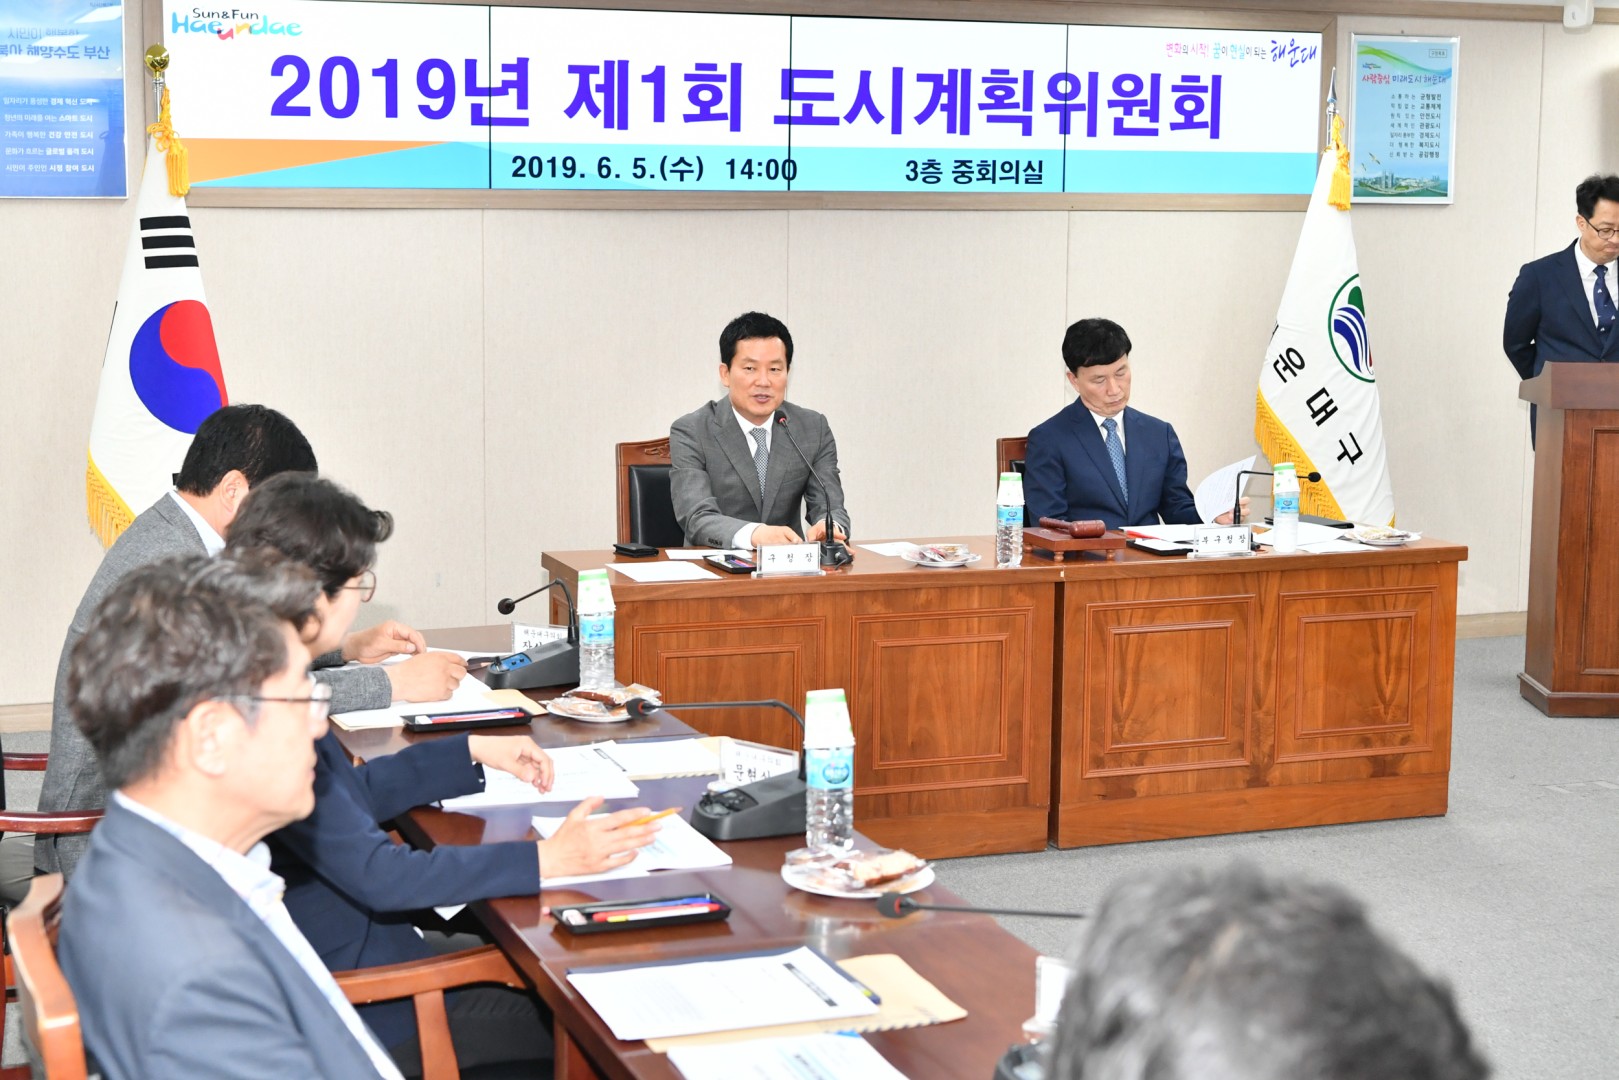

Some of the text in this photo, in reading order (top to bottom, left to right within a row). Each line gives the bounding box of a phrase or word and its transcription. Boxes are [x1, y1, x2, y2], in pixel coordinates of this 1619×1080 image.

[192, 7, 259, 20] Sun&Fun
[171, 11, 303, 41] Haeundae
[8, 27, 42, 40] 시민이
[26, 44, 80, 59] 해양수도
[84, 45, 111, 60] 부산
[1166, 38, 1318, 68] 변화의 시작! 꿈이 현실이 되는 해운대
[1362, 73, 1447, 85] 사람중심 미래도시 해운대
[3, 97, 28, 105] 일자리가
[50, 98, 64, 106] 경제
[65, 98, 78, 106] 혁신
[271, 55, 1222, 140] 2019년 제1회 도시계획위원회
[5, 114, 23, 122] 청년의
[24, 114, 43, 122] 미래를
[59, 114, 78, 122] 스마트
[80, 114, 93, 123] 도시
[5, 131, 94, 139] 가족이 행복한 건강 안전 도시
[5, 147, 24, 155] 문화가
[26, 147, 44, 155] 흐르는
[45, 147, 65, 155] 글로벌
[81, 147, 94, 155] 도시
[6, 164, 26, 172] 시민이
[49, 164, 63, 172] 시정
[65, 164, 79, 172] 참여
[81, 164, 95, 172] 도시
[511, 155, 1044, 186] 2019. 6. 5.(수) 14:00 3층 중회의실
[1272, 345, 1364, 466] 운대구
